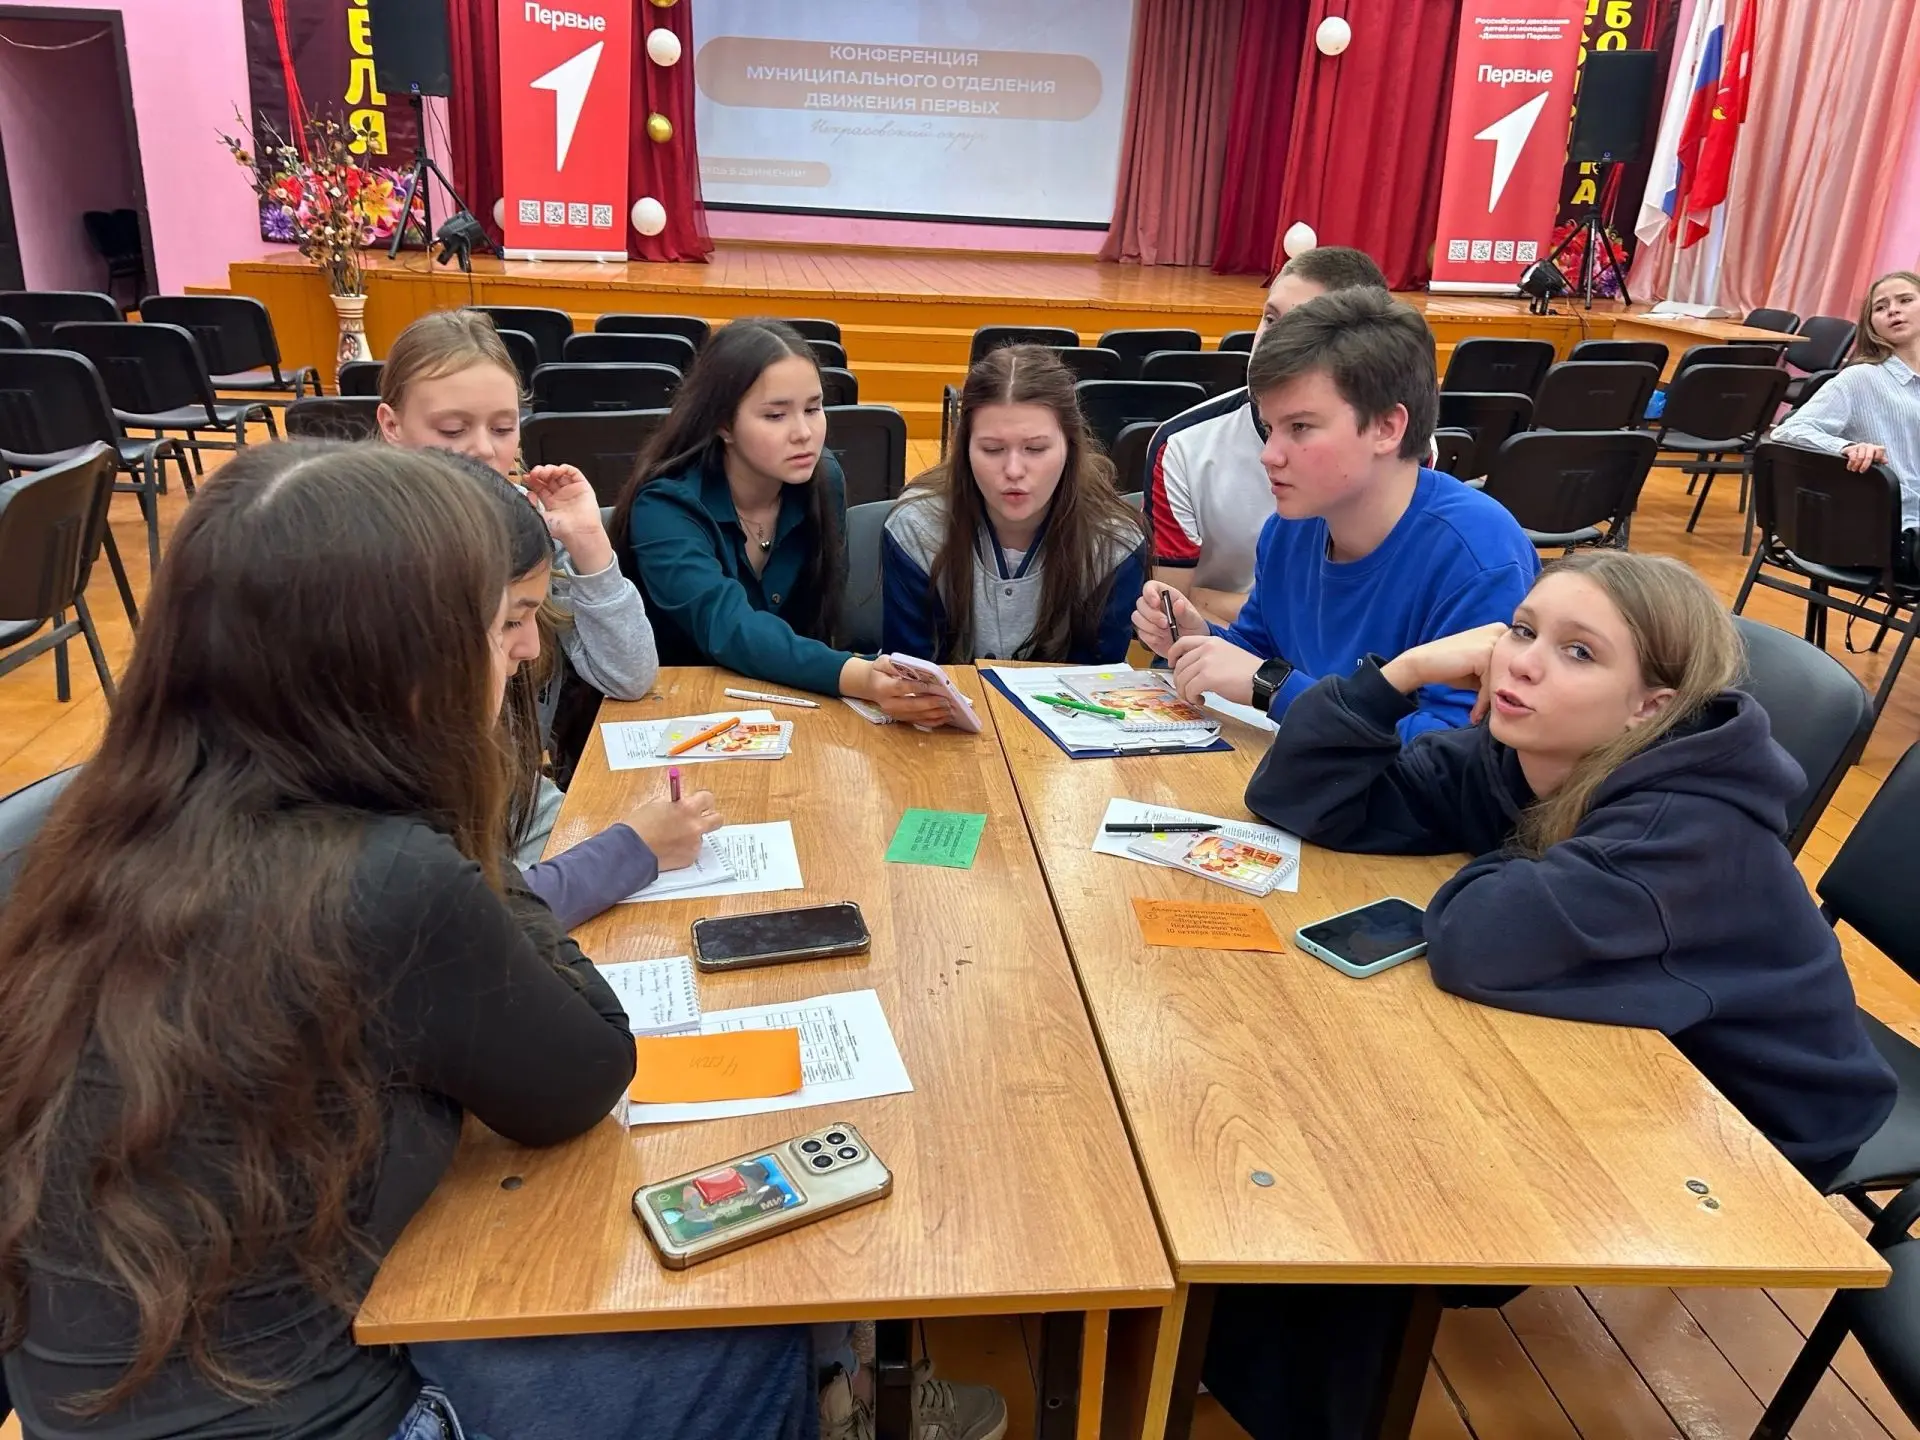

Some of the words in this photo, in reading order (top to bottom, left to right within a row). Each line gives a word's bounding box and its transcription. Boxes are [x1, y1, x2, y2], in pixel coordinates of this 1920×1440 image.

[524, 1, 606, 32] Первые
[829, 45, 978, 68] КОНФЕРЕНЦИЯ
[746, 66, 937, 88] МУНИЦИПАЛЬНОГО
[942, 75, 1056, 94] ОТДЕЛЕНИЯ
[1477, 64, 1553, 88] Первые
[804, 92, 916, 111] ДВИЖЕНИЯ
[921, 98, 1000, 115] ПЕРВЫХ
